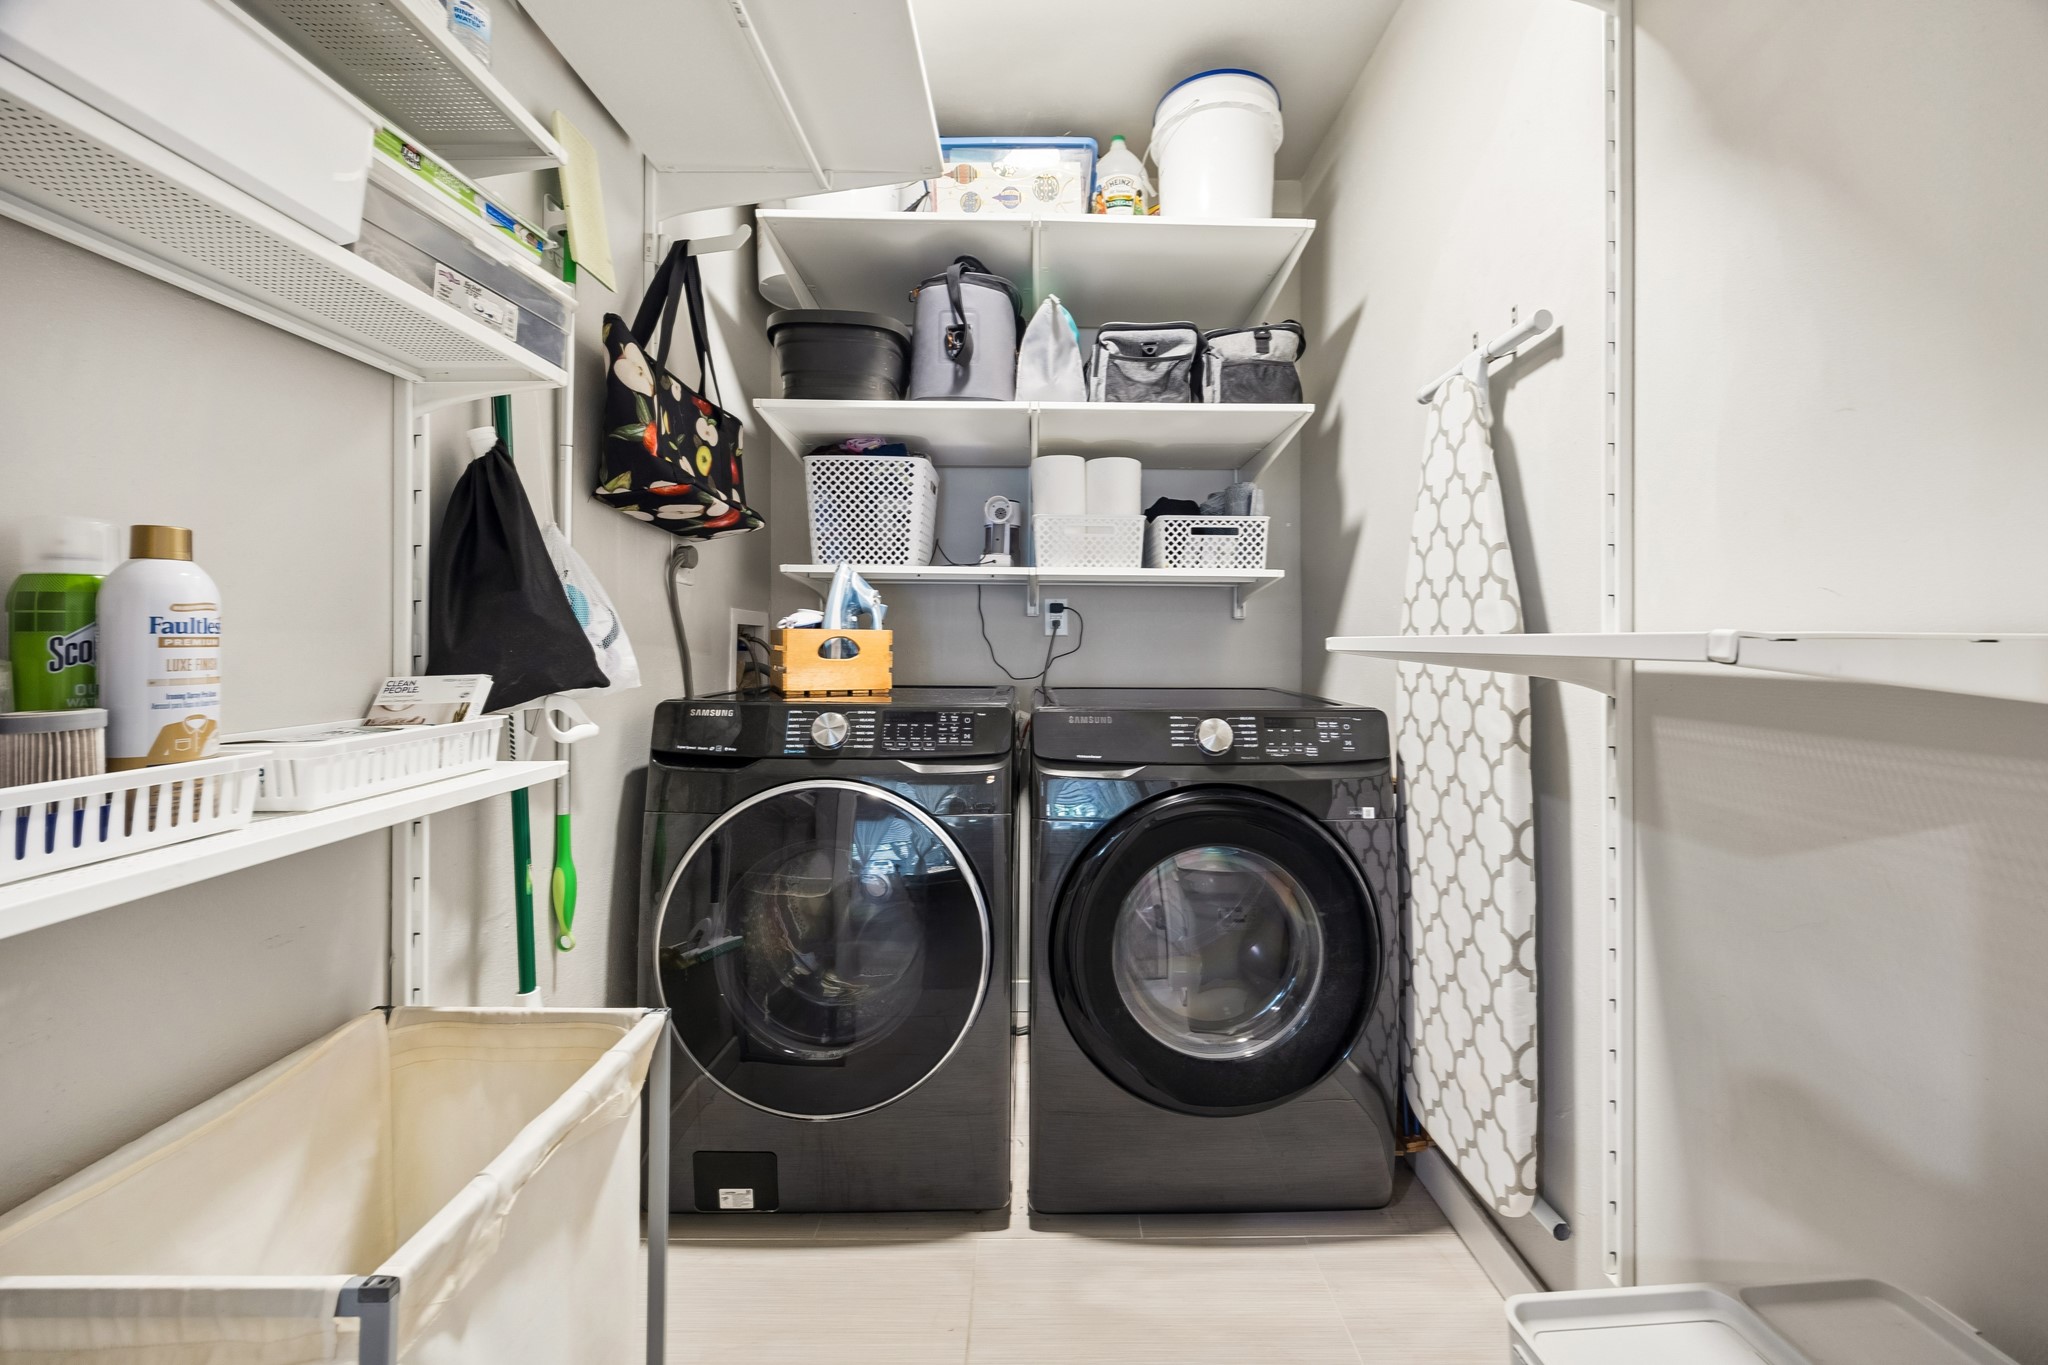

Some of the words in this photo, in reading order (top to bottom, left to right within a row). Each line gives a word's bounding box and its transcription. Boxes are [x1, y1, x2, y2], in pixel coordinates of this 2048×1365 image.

[454, 13, 481, 28] WATER
[1109, 179, 1131, 187] HEINZ
[166, 658, 193, 672] LUXE
[690, 708, 734, 717] SAMSUNG
[1068, 715, 1113, 724] SAMSUNG
